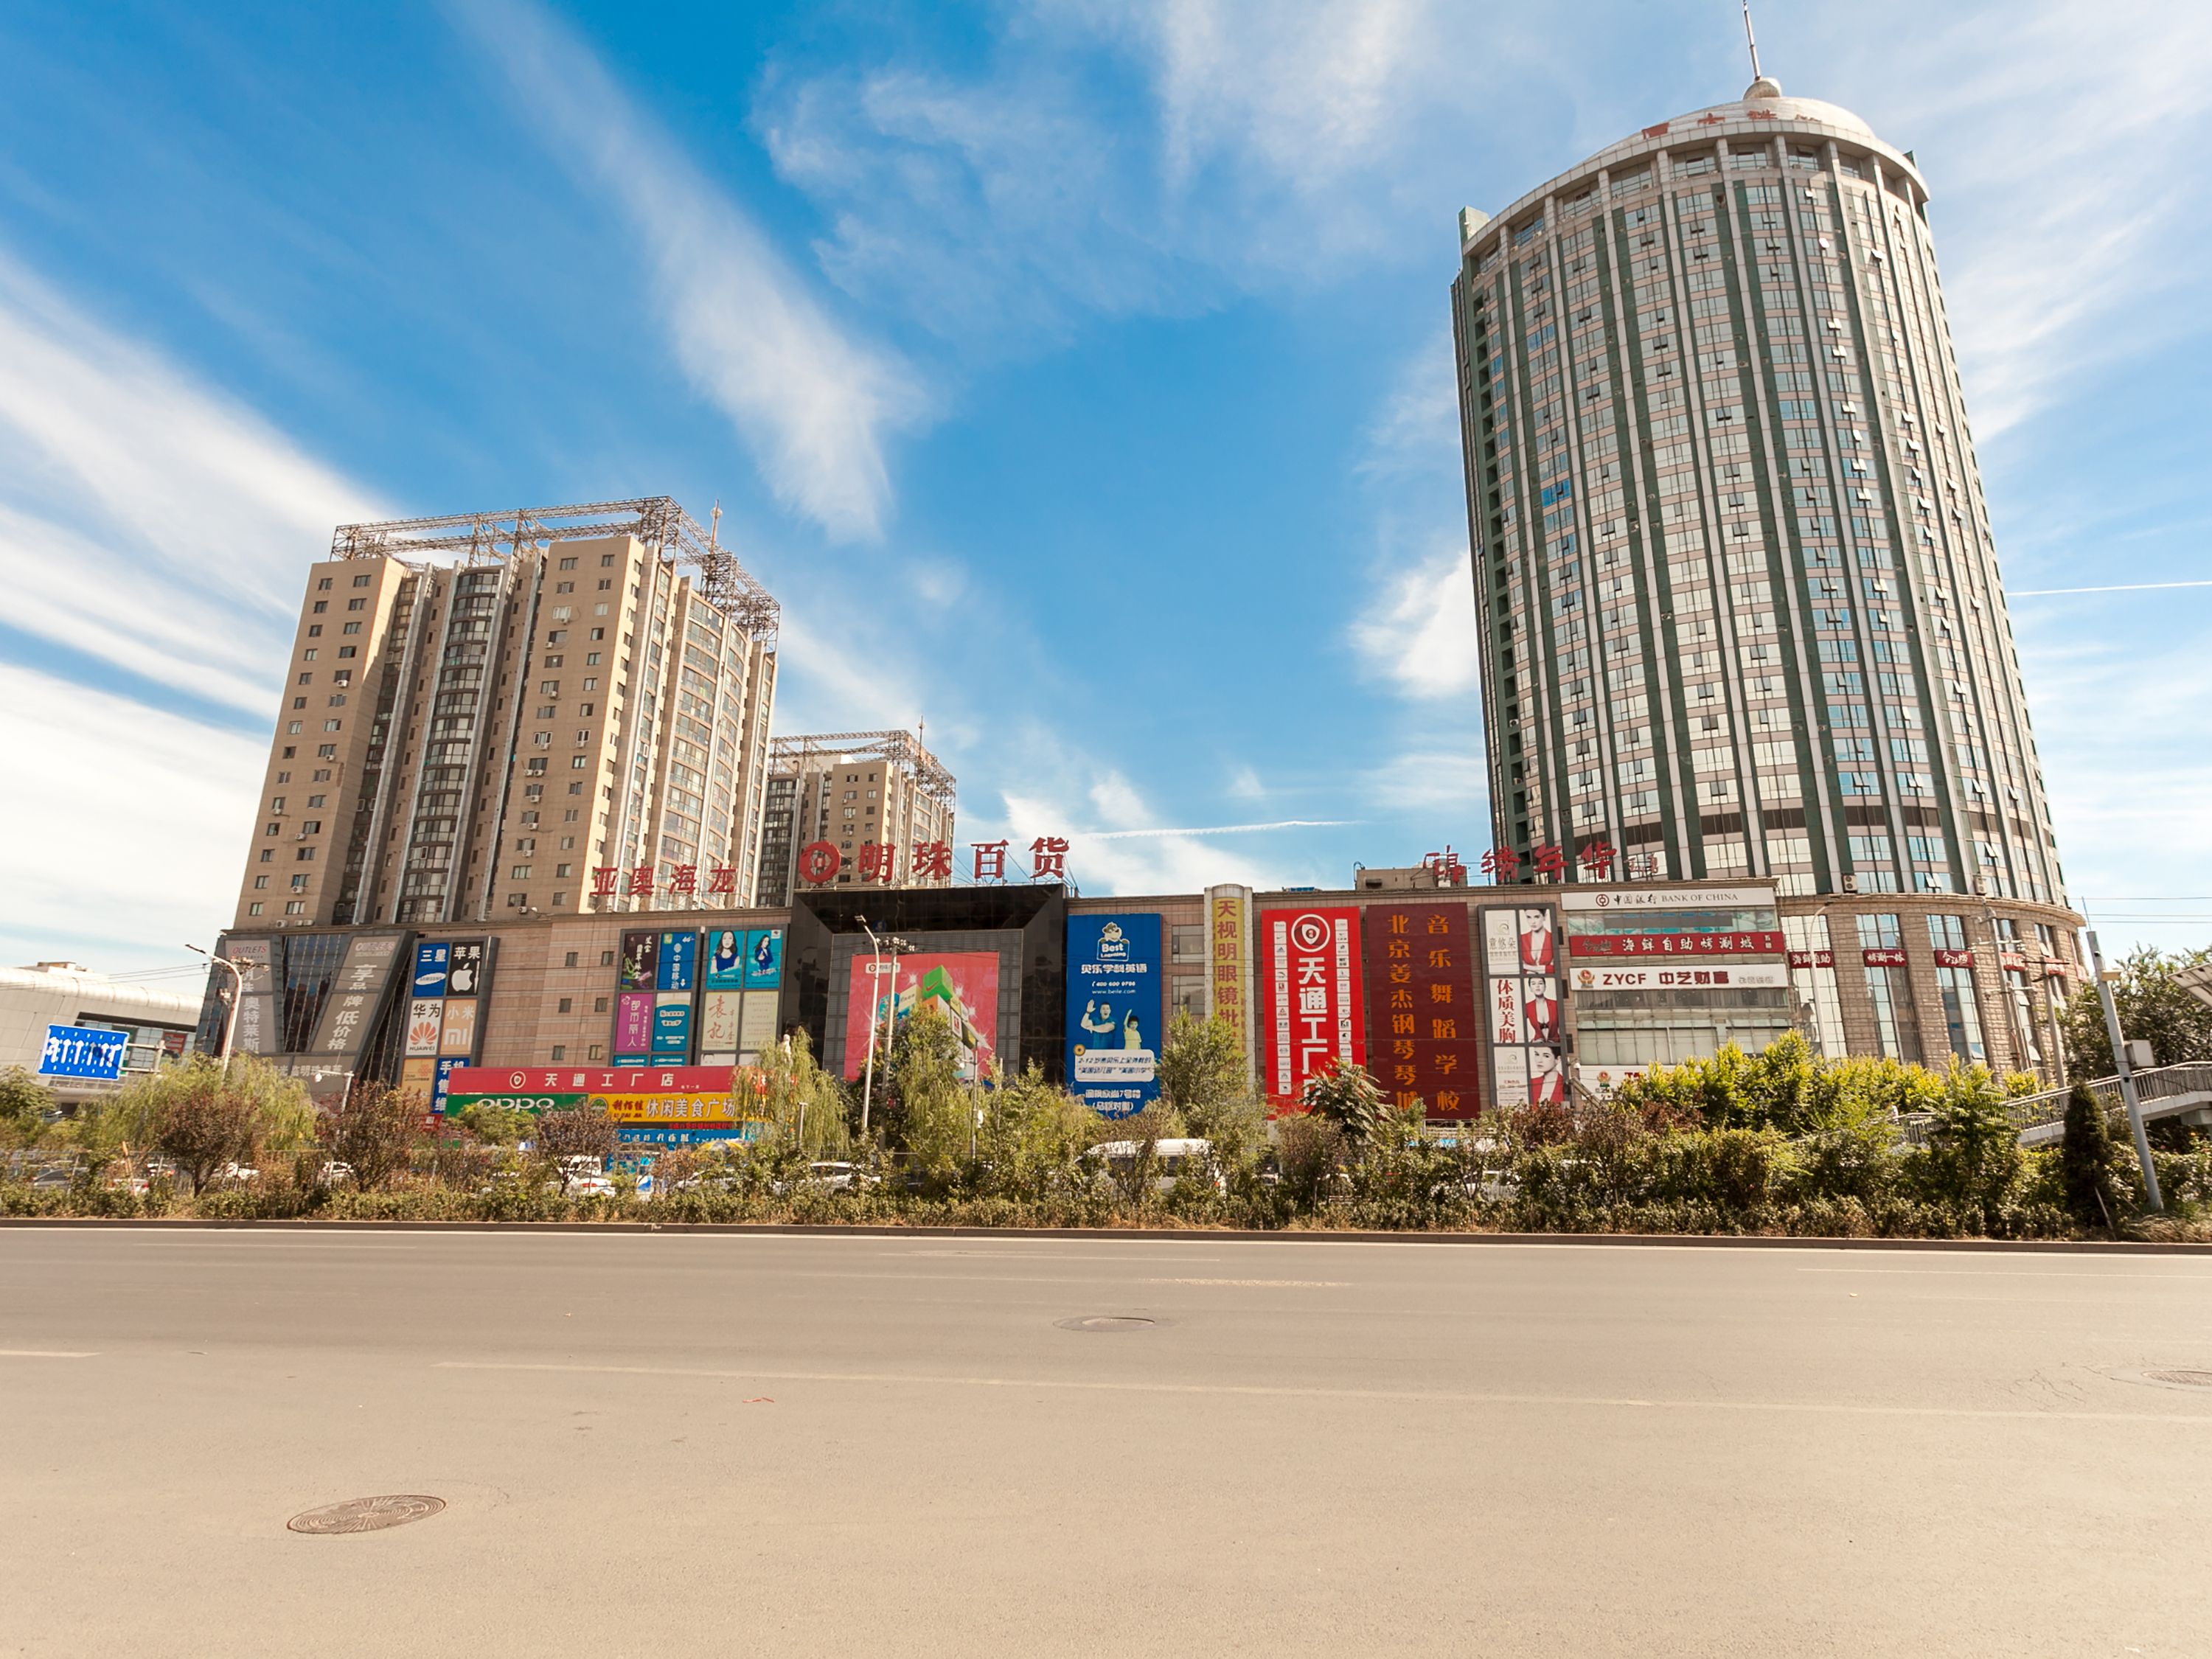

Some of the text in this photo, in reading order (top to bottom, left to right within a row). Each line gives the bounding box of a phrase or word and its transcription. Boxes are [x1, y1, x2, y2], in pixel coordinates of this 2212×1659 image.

[858, 836, 1070, 883] 明珠百货
[589, 863, 737, 897] 亚奥海龙
[1613, 894, 1658, 905] 中国银行
[1661, 894, 1688, 902] BANK
[1705, 893, 1739, 901] CHINA
[232, 945, 267, 954] OUTLETS
[420, 948, 447, 962] 三星
[453, 945, 481, 960] 苹果
[1102, 943, 1124, 953] Best
[1217, 900, 1239, 1050] 天视明眼镜批
[1602, 973, 1646, 986] ZYCF
[1659, 970, 1731, 986] 中艺财富
[412, 1003, 441, 1019] 华为
[447, 1005, 475, 1020] 小米
[1427, 914, 1461, 1112] 音乐舞蹈学校
[545, 1073, 674, 1088] 天通工厂店
[646, 1098, 736, 1119] 休闲美食广场
